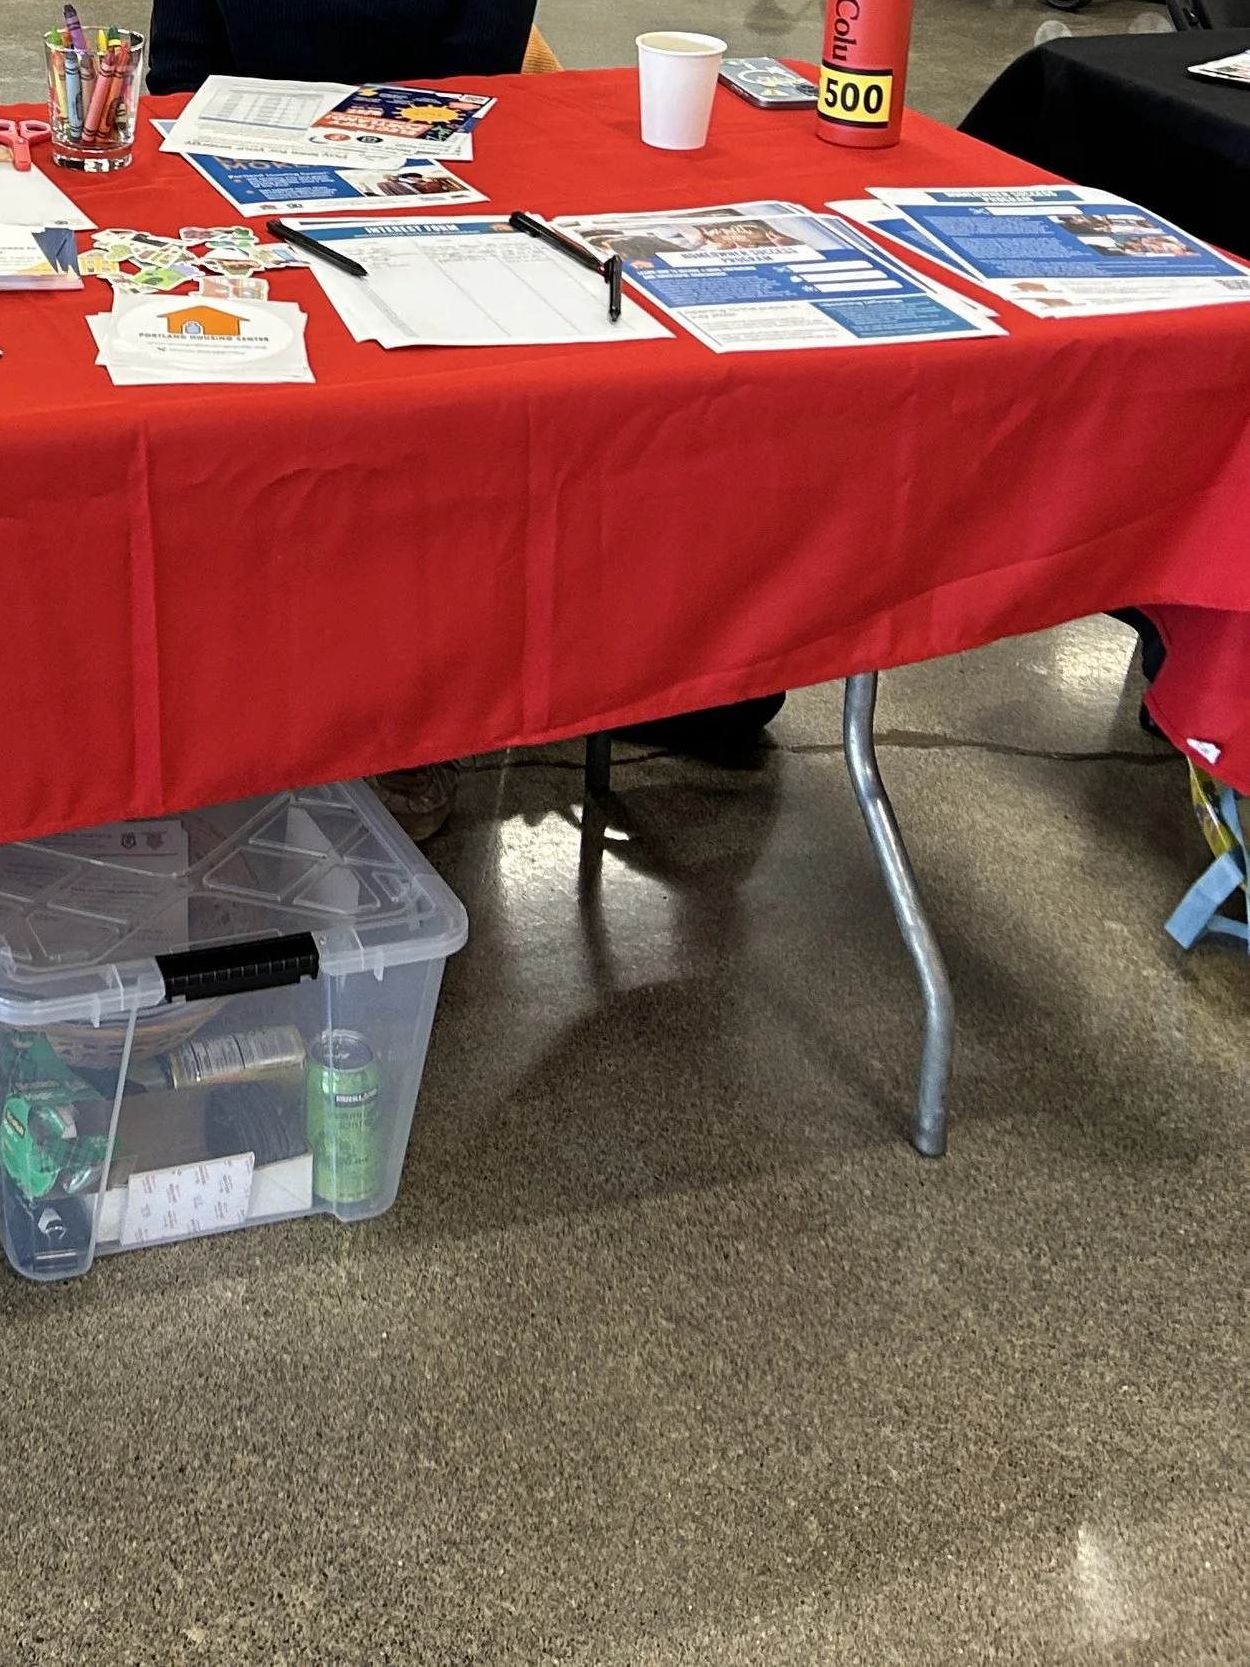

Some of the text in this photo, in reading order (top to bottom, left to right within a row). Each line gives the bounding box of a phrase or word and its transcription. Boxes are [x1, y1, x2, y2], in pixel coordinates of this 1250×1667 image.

[824, 77, 884, 114] 500
[364, 223, 460, 234] INTEREST FORM
[720, 256, 774, 264] PROGRAM
[139, 332, 186, 340] PORTLAND
